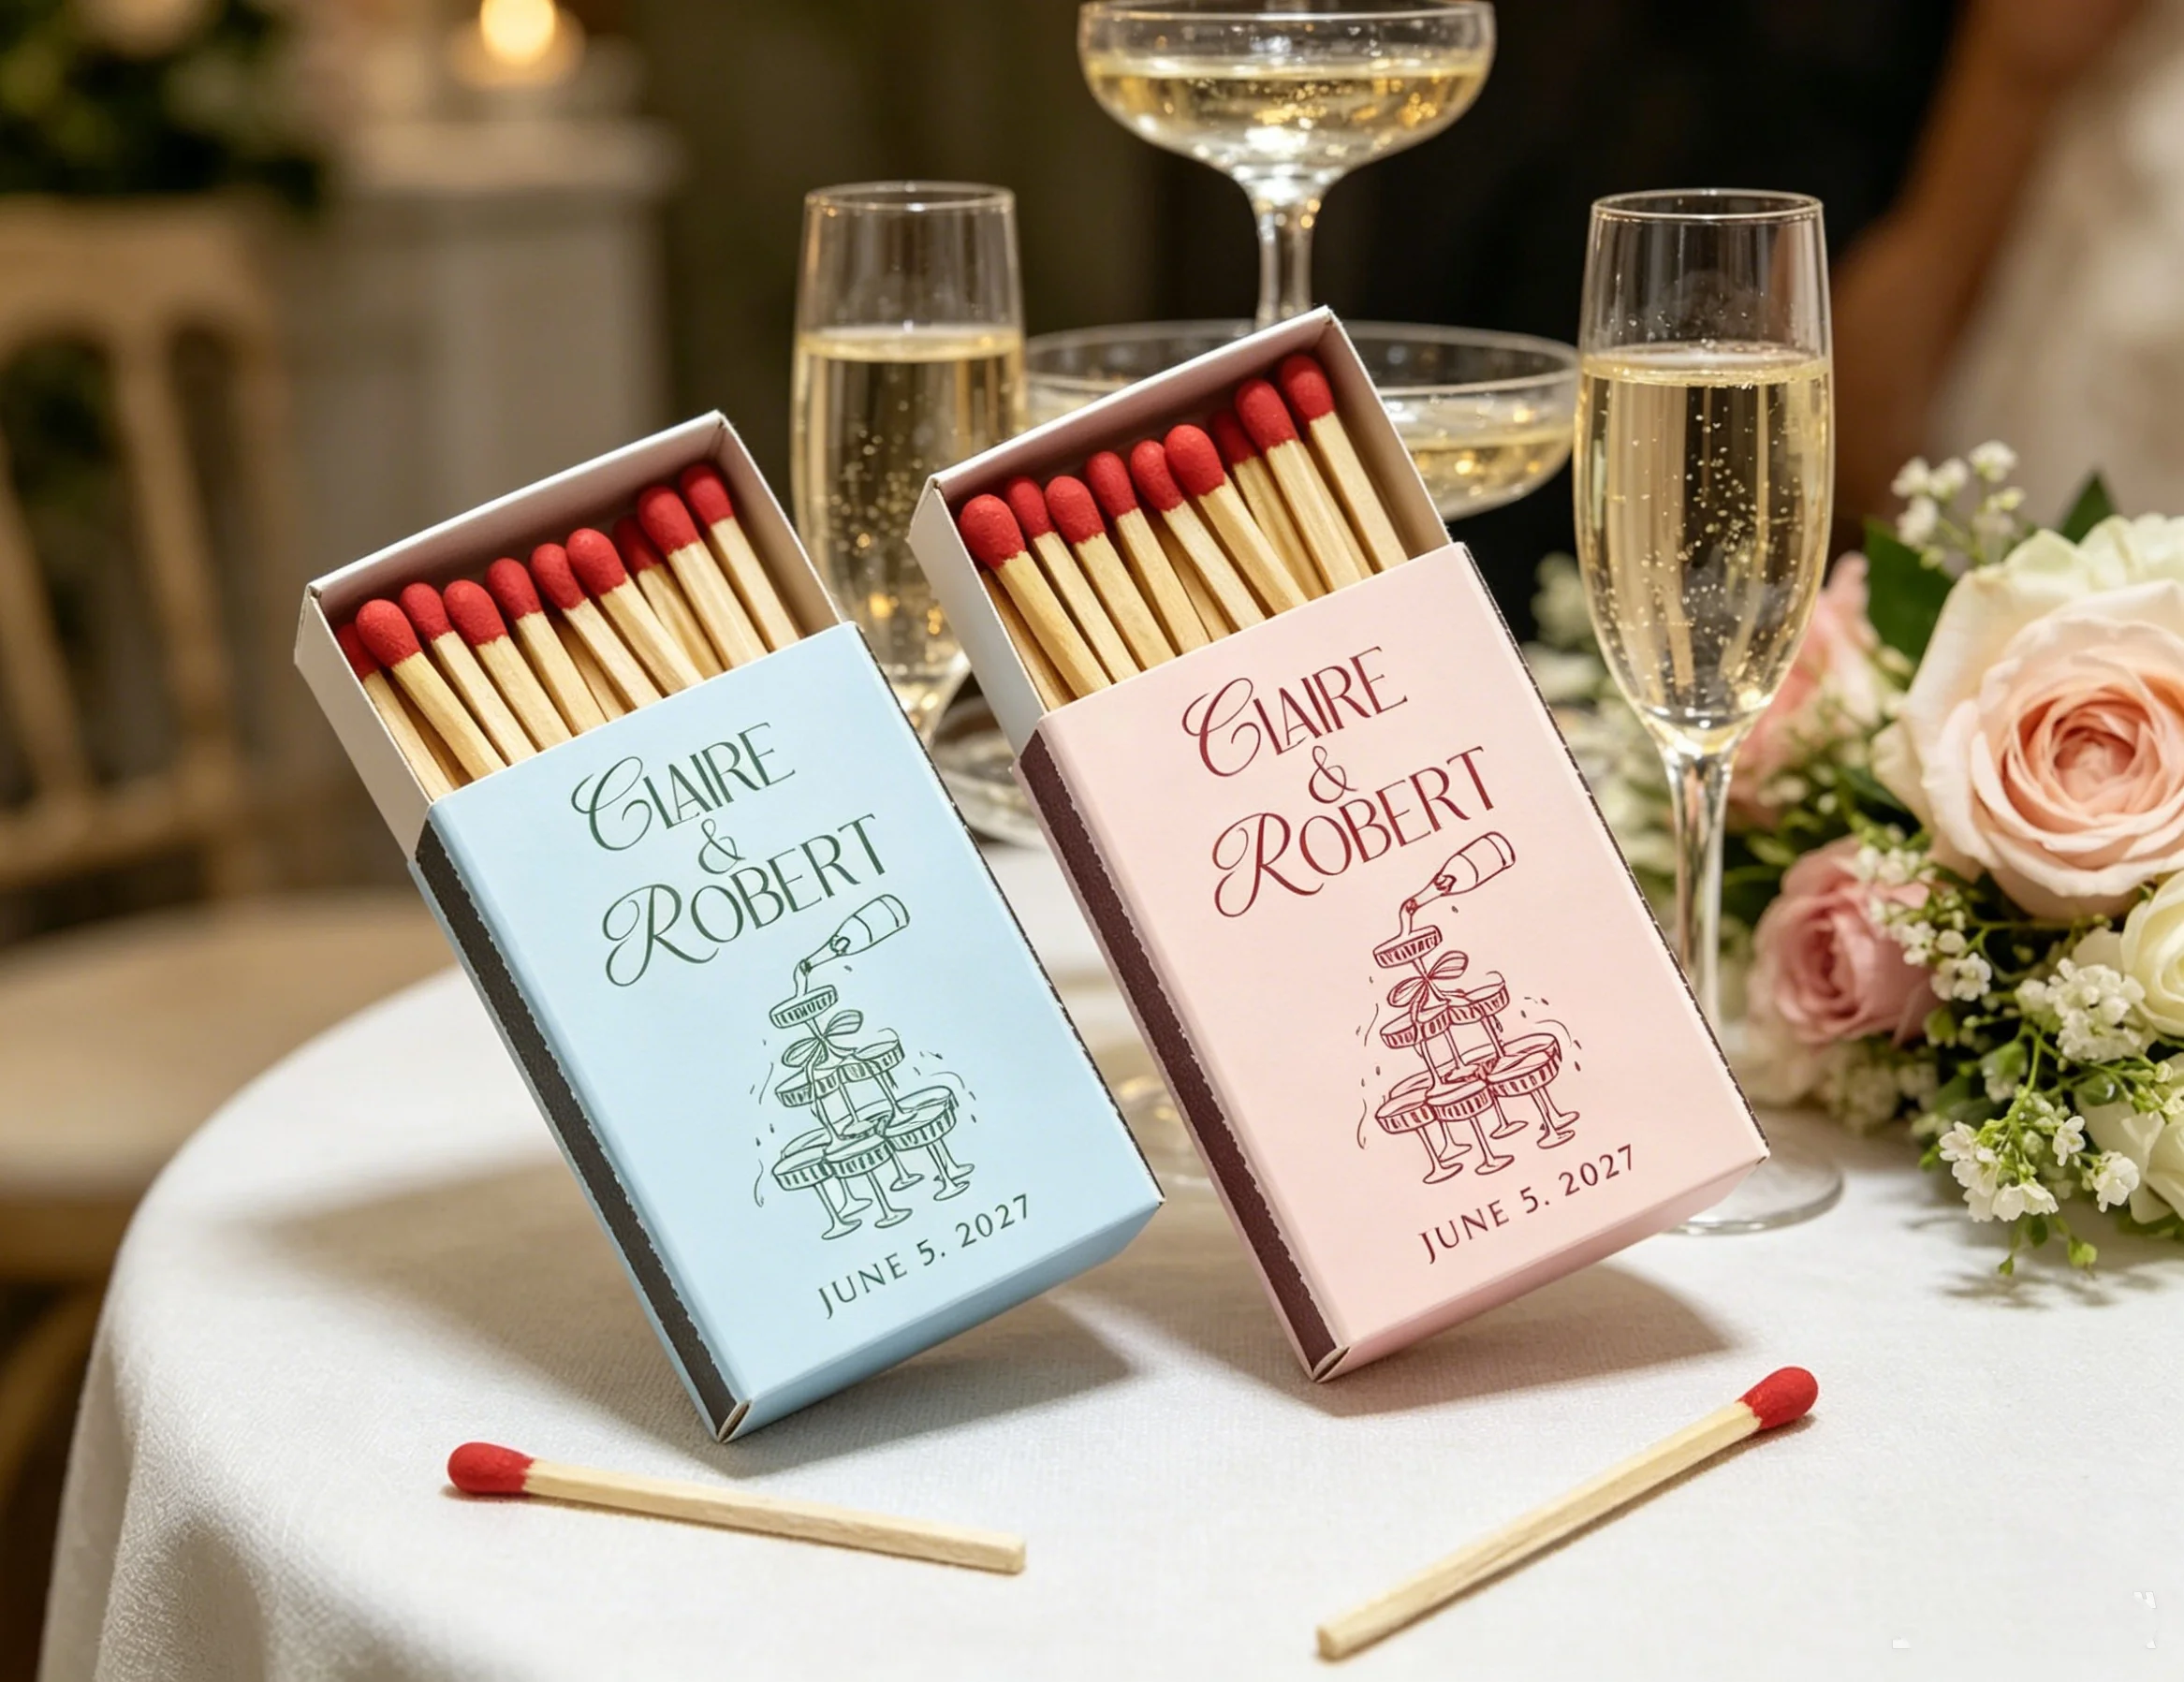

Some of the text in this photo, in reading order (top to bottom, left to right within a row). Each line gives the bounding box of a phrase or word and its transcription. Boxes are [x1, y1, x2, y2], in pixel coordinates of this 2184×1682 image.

[1181, 646, 1408, 777] CLAIRE
[1308, 745, 1359, 805] &
[571, 722, 796, 851] CLAIRE
[697, 817, 747, 875] &
[1212, 745, 1495, 917] ROBERT
[602, 812, 887, 987] ROBERT
[817, 1252, 908, 1320] JUNE
[955, 1192, 1028, 1248] 2027
[1417, 1199, 1510, 1265] JUNE
[1558, 1144, 1633, 1197] 2027
